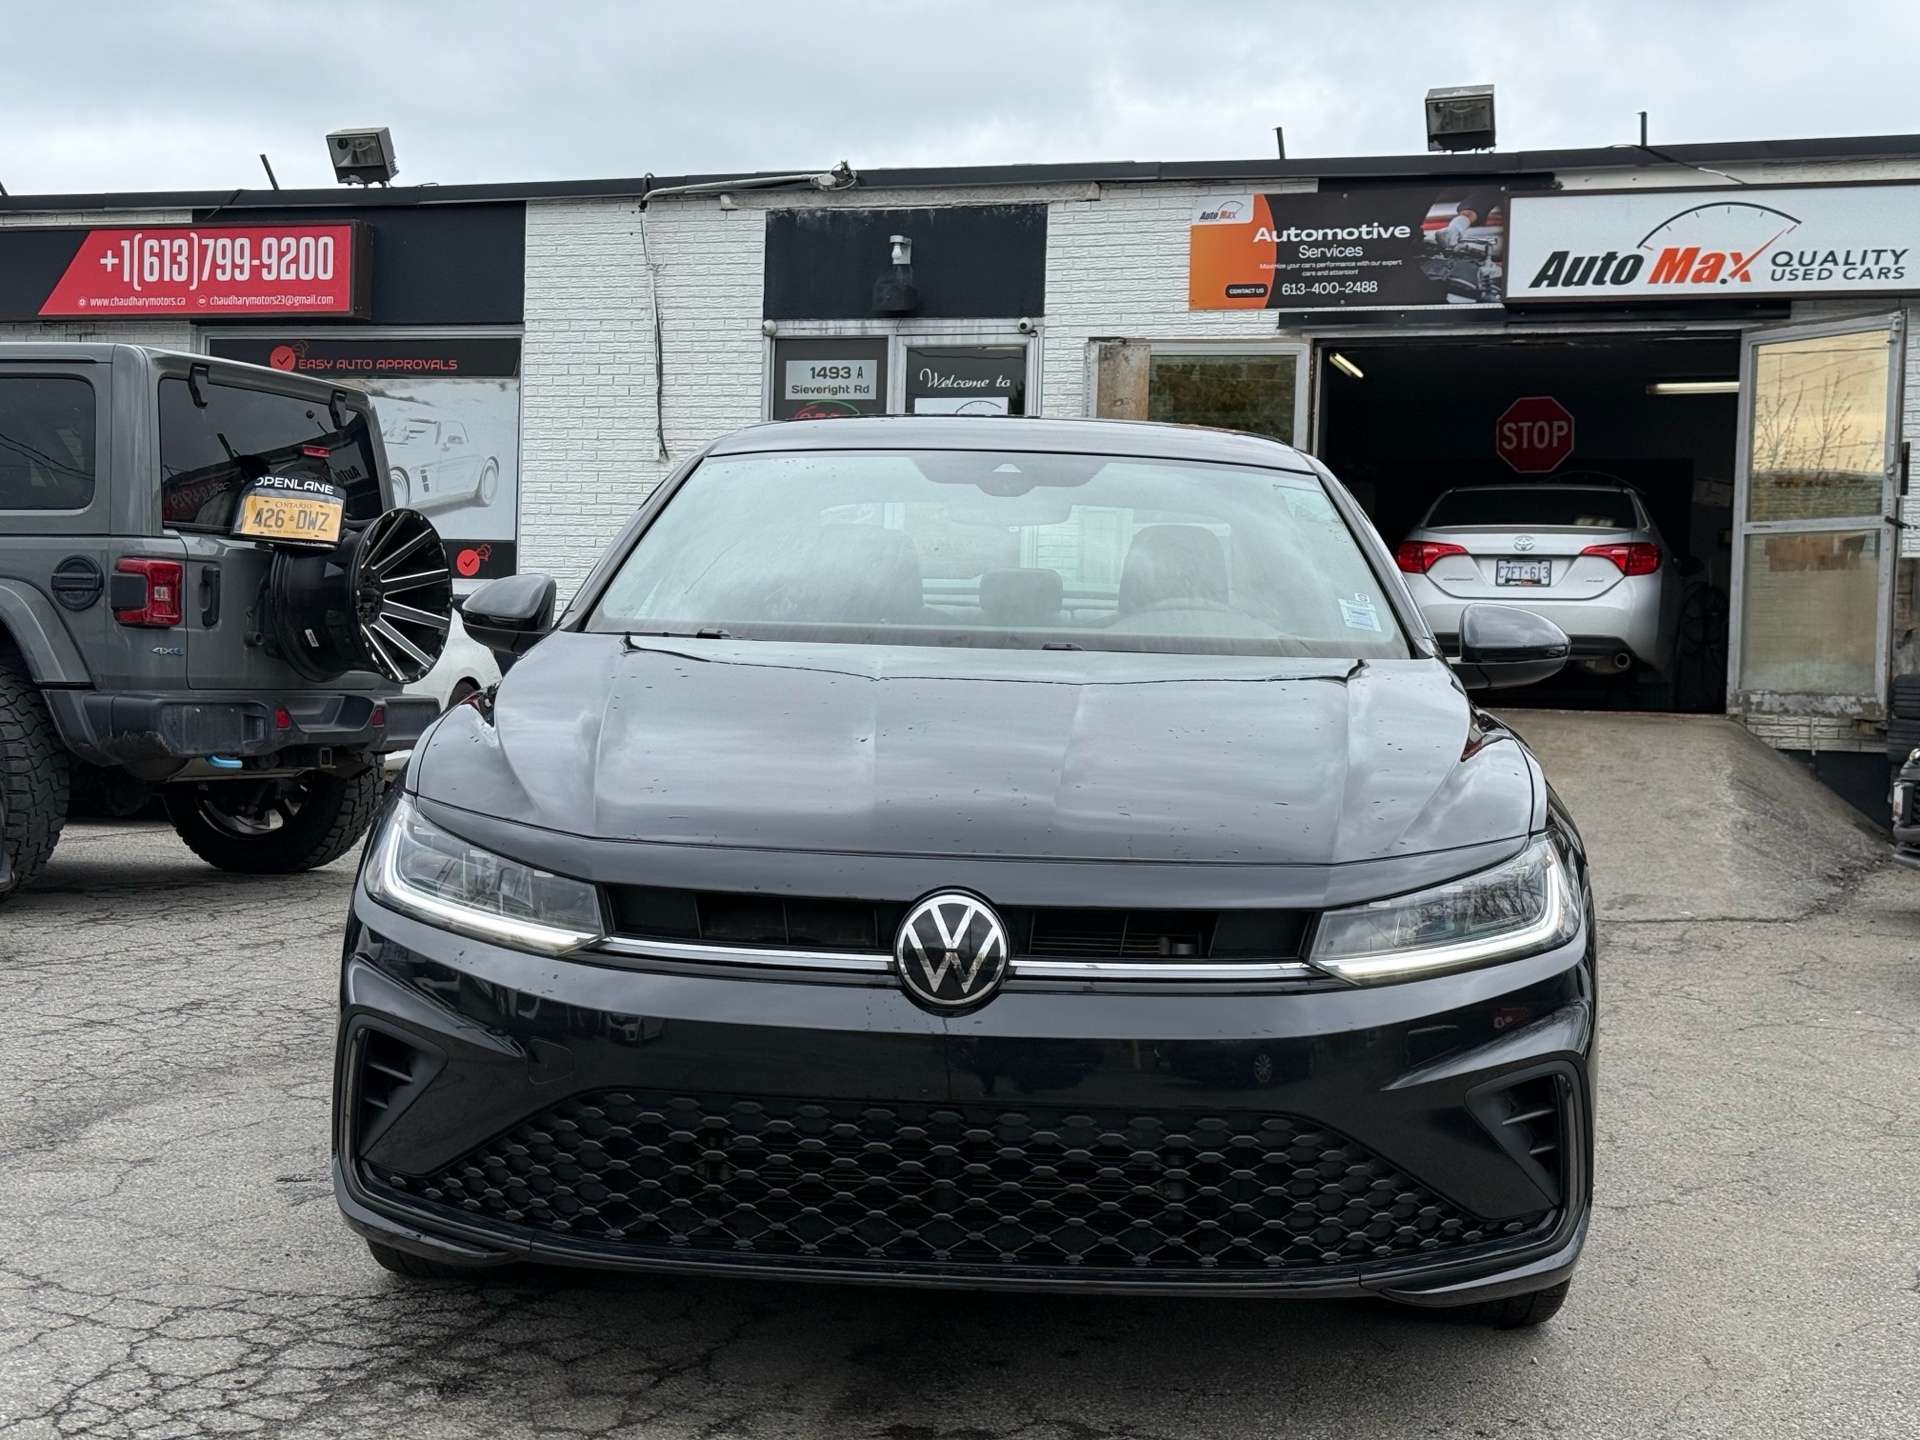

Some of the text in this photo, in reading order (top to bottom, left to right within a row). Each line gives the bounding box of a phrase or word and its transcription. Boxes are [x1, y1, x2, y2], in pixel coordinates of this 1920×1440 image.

[1253, 222, 1411, 243] Automotive
[1299, 244, 1364, 259] Services
[1770, 248, 1909, 269] QUALITY
[1528, 250, 1644, 289] Auto
[1770, 265, 1905, 282] USED CARS
[1281, 280, 1378, 296] 613-400-2488
[90, 297, 186, 307] www.chaudharymotors.ca
[210, 295, 334, 307] chaudharymotors23@gmail.com
[299, 359, 457, 370] EASY AUTO APPROVALS
[809, 366, 864, 380] 1493 A
[919, 368, 1011, 388] Welcome to
[791, 384, 870, 396] Sieveright Rd
[1502, 420, 1569, 450] STOP
[255, 476, 336, 495] OPENLANE
[252, 507, 330, 532] 426 DWZ
